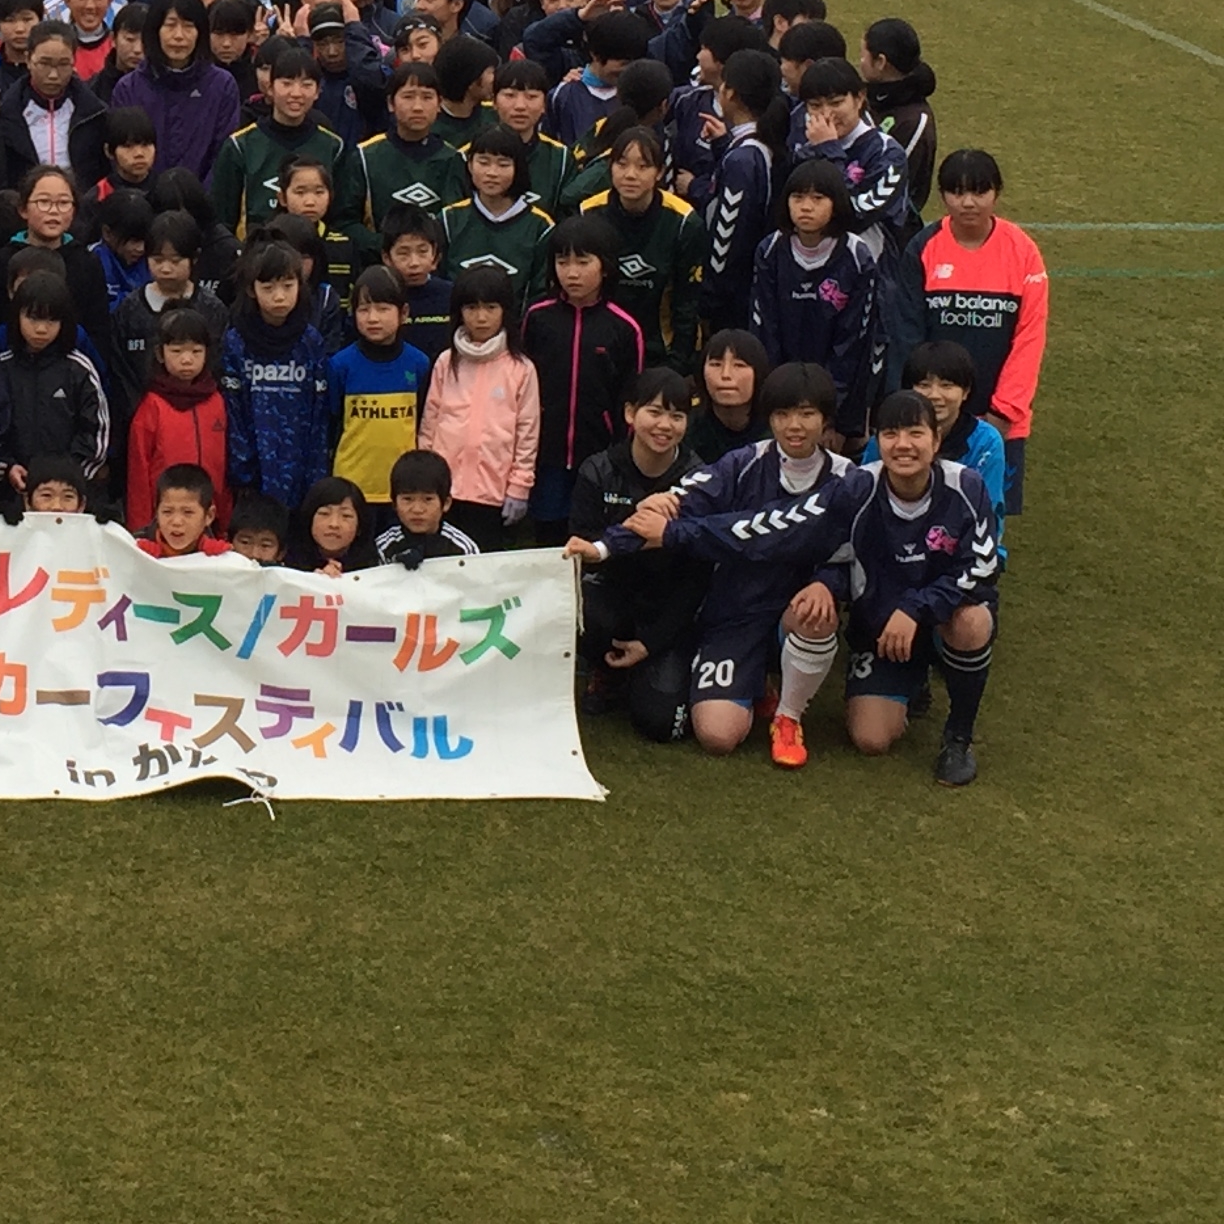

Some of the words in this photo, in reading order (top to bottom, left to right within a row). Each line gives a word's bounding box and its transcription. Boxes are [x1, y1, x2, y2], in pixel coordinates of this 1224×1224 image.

[955, 293, 1018, 313] balance
[940, 310, 1003, 327] football
[350, 406, 414, 419] ATHLETA
[697, 659, 735, 689] 20
[66, 759, 116, 787] in
